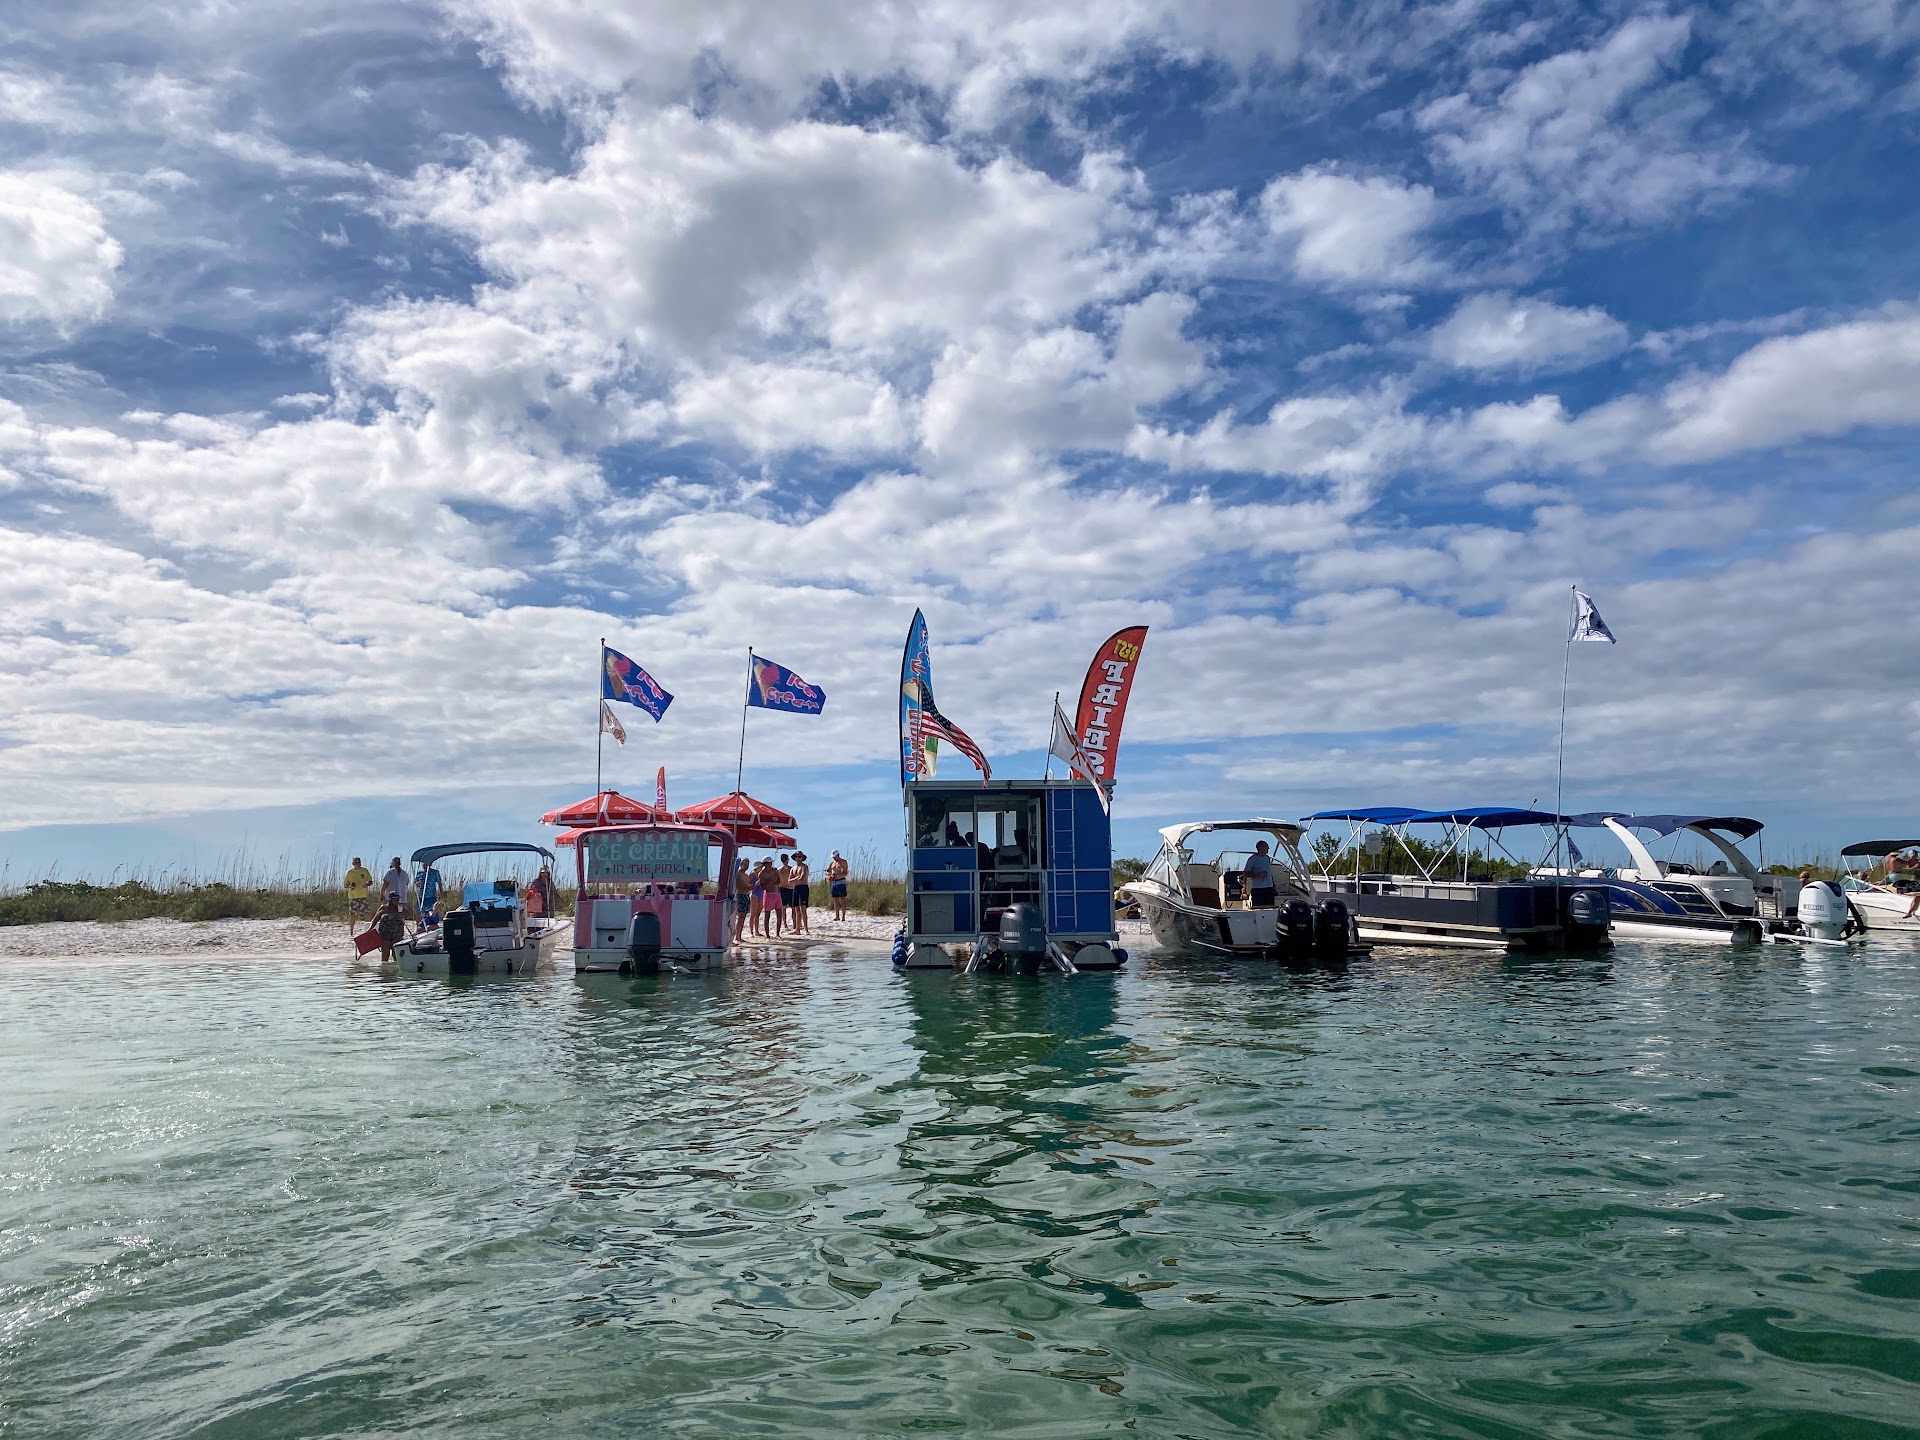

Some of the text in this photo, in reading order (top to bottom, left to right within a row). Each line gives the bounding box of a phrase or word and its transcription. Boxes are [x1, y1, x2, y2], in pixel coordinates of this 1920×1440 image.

[590, 843, 623, 861] ICE
[613, 864, 625, 875] IN
[628, 863, 652, 875] THE
